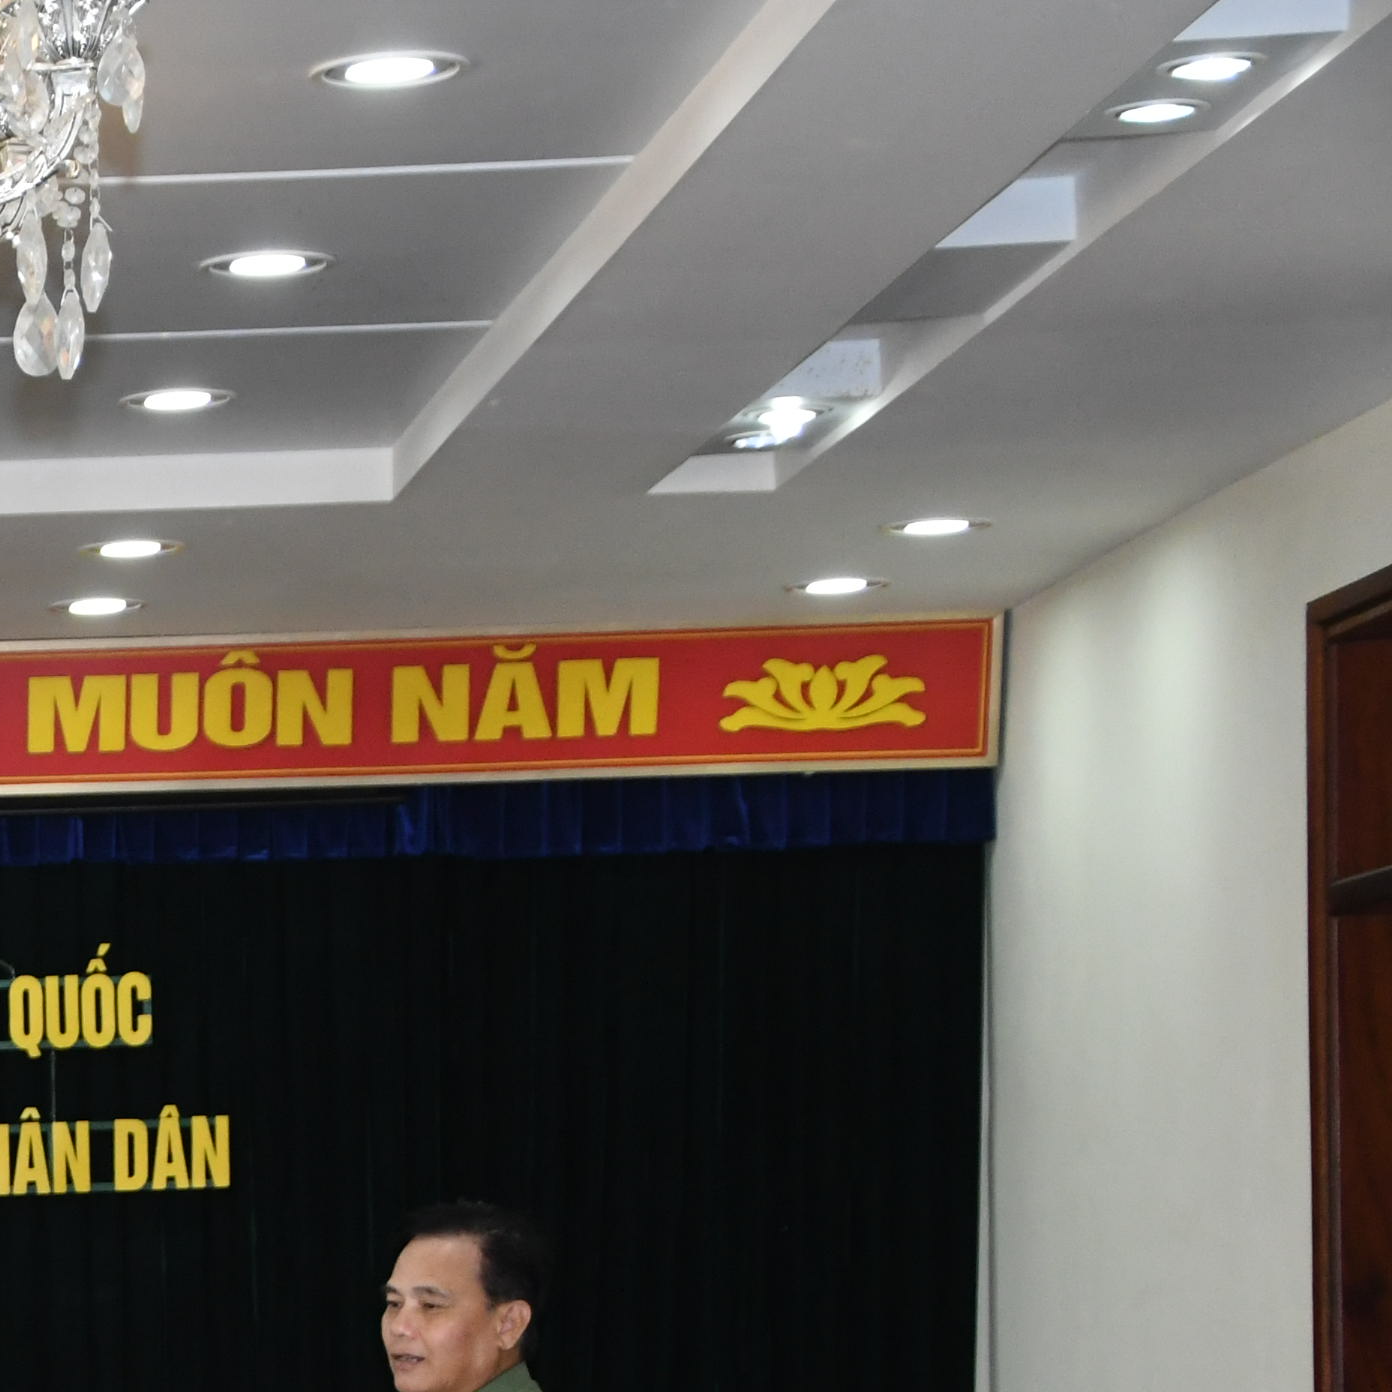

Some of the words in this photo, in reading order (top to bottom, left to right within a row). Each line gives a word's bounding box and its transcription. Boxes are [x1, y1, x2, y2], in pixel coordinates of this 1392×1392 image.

[26, 650, 354, 754] MUÔN
[391, 644, 660, 744] NĂM
[8, 943, 153, 1058] QUỐC
[113, 1104, 231, 1192] DÂN
